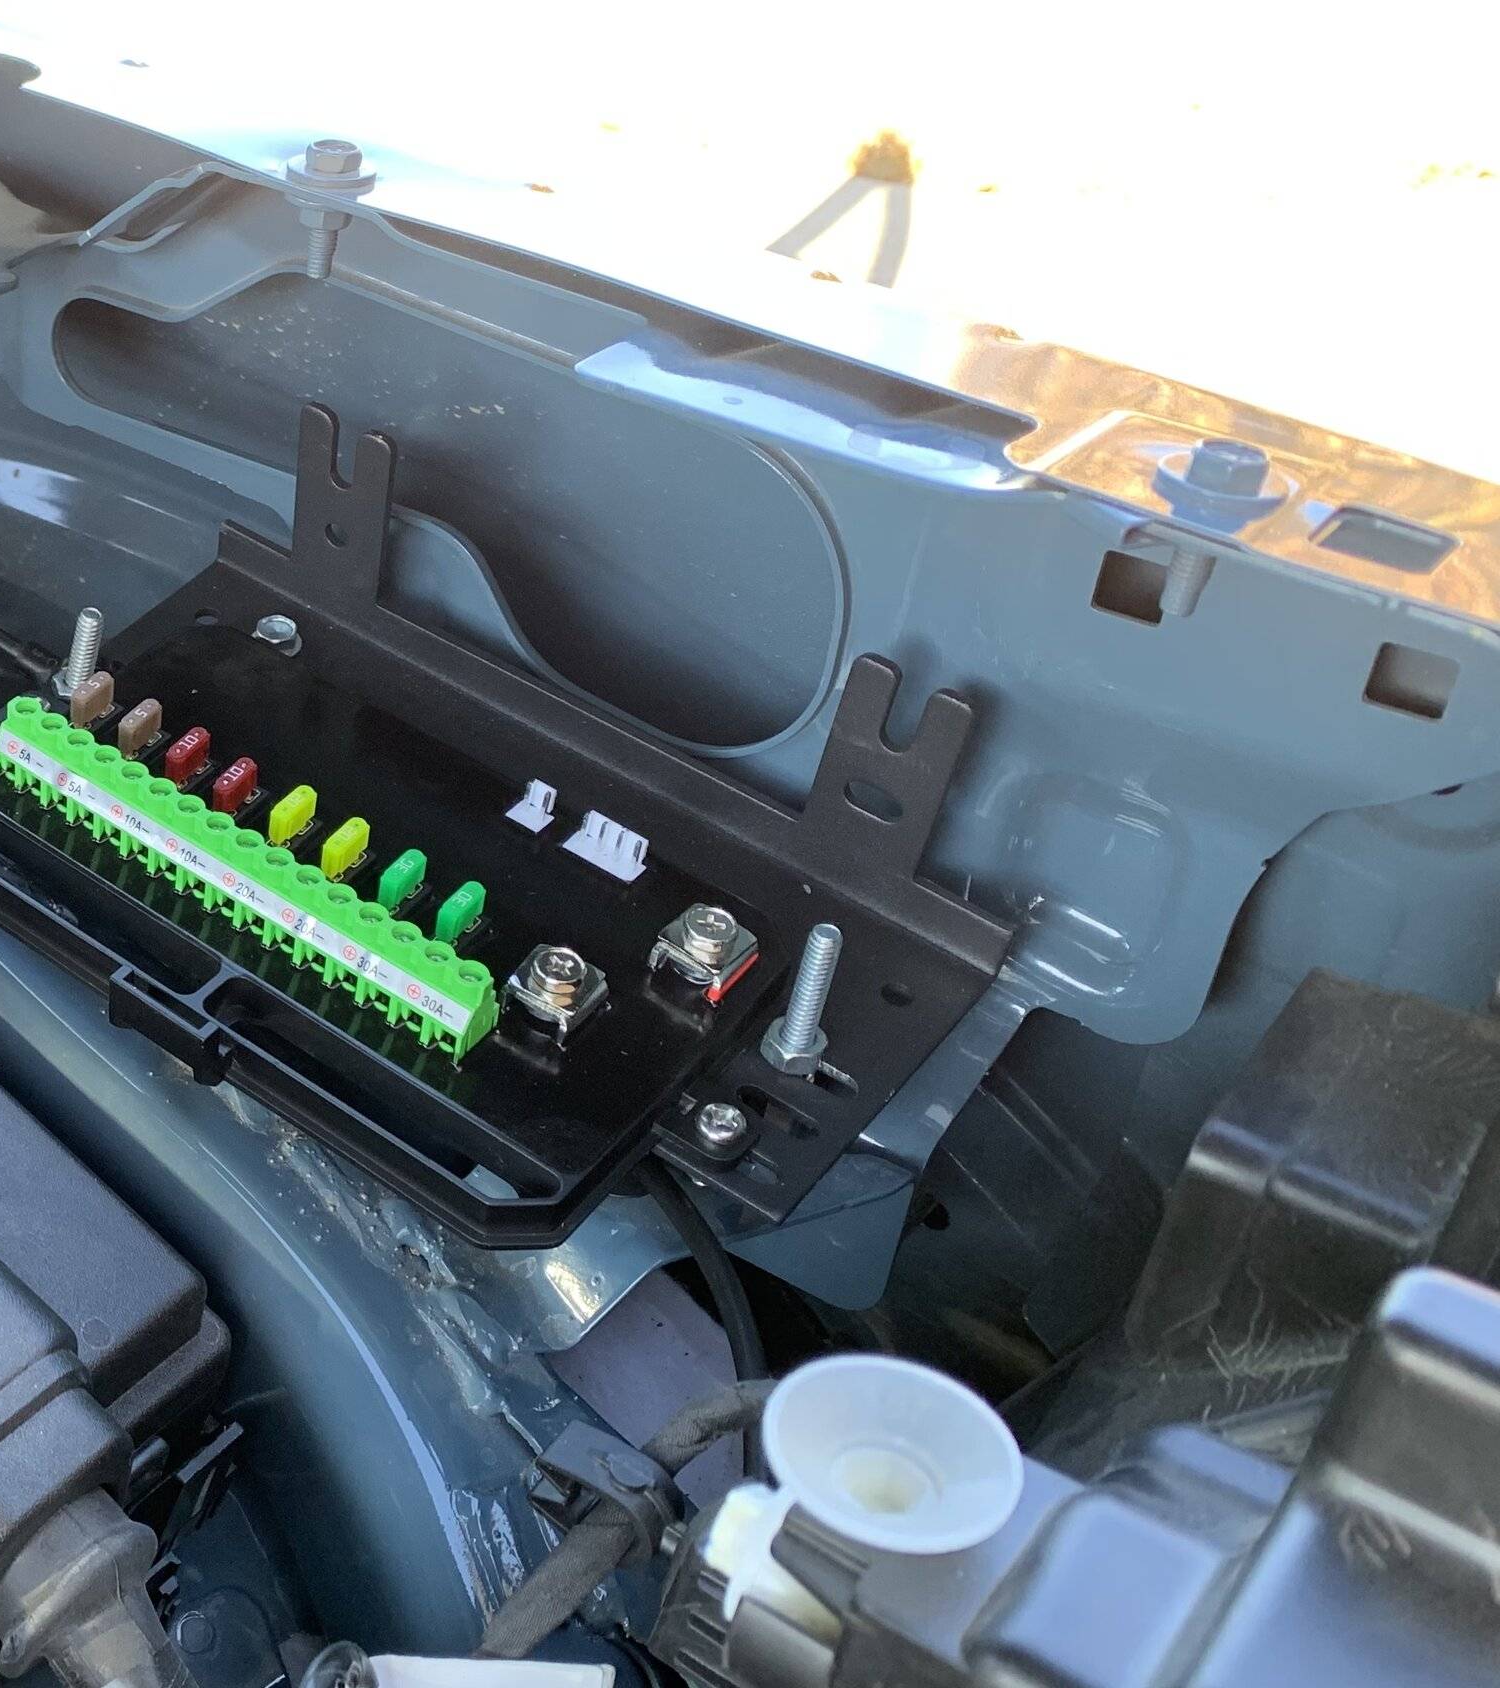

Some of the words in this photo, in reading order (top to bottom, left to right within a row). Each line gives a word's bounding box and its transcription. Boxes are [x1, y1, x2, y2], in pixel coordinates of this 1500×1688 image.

[88, 680, 100, 689] 5
[134, 708, 148, 718] 5
[179, 735, 199, 750] 10
[224, 765, 244, 781] 10
